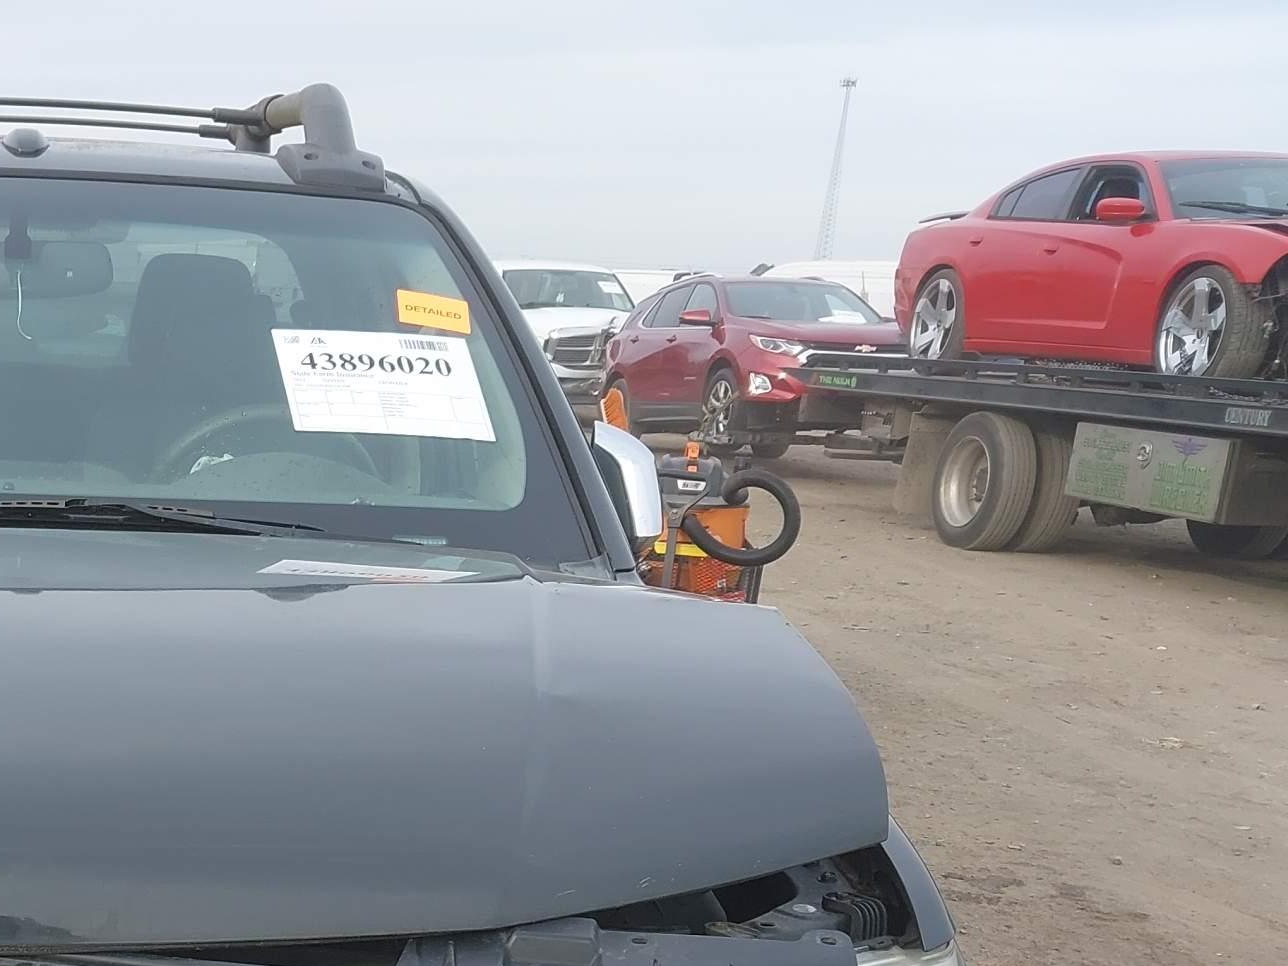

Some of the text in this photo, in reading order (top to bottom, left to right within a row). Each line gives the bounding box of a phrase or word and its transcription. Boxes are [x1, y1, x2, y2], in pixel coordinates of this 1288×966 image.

[404, 304, 462, 320] DETAILED
[300, 352, 452, 377] 43896020
[1225, 407, 1272, 426] CENTURY
